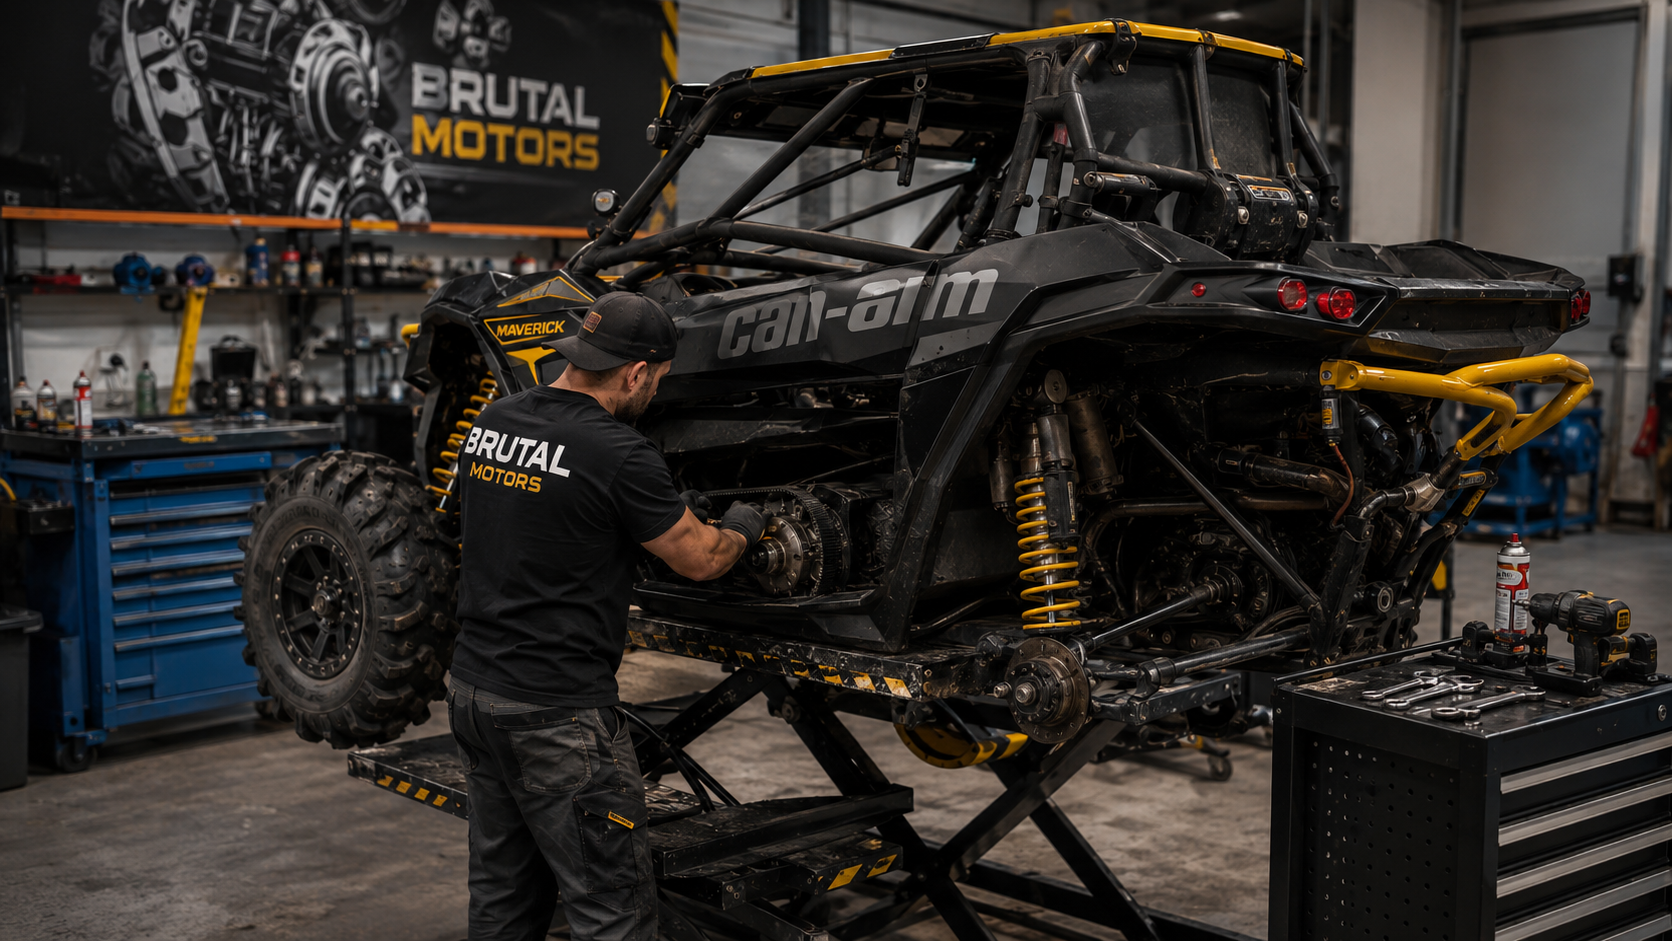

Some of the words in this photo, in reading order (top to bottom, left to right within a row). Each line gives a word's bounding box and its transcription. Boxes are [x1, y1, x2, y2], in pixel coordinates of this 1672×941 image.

[411, 62, 600, 130] BRUTAL
[411, 114, 600, 171] MOTORS
[496, 320, 566, 337] MAVERICK
[464, 426, 571, 478] BRUTAL
[469, 461, 542, 493] MOTORS
